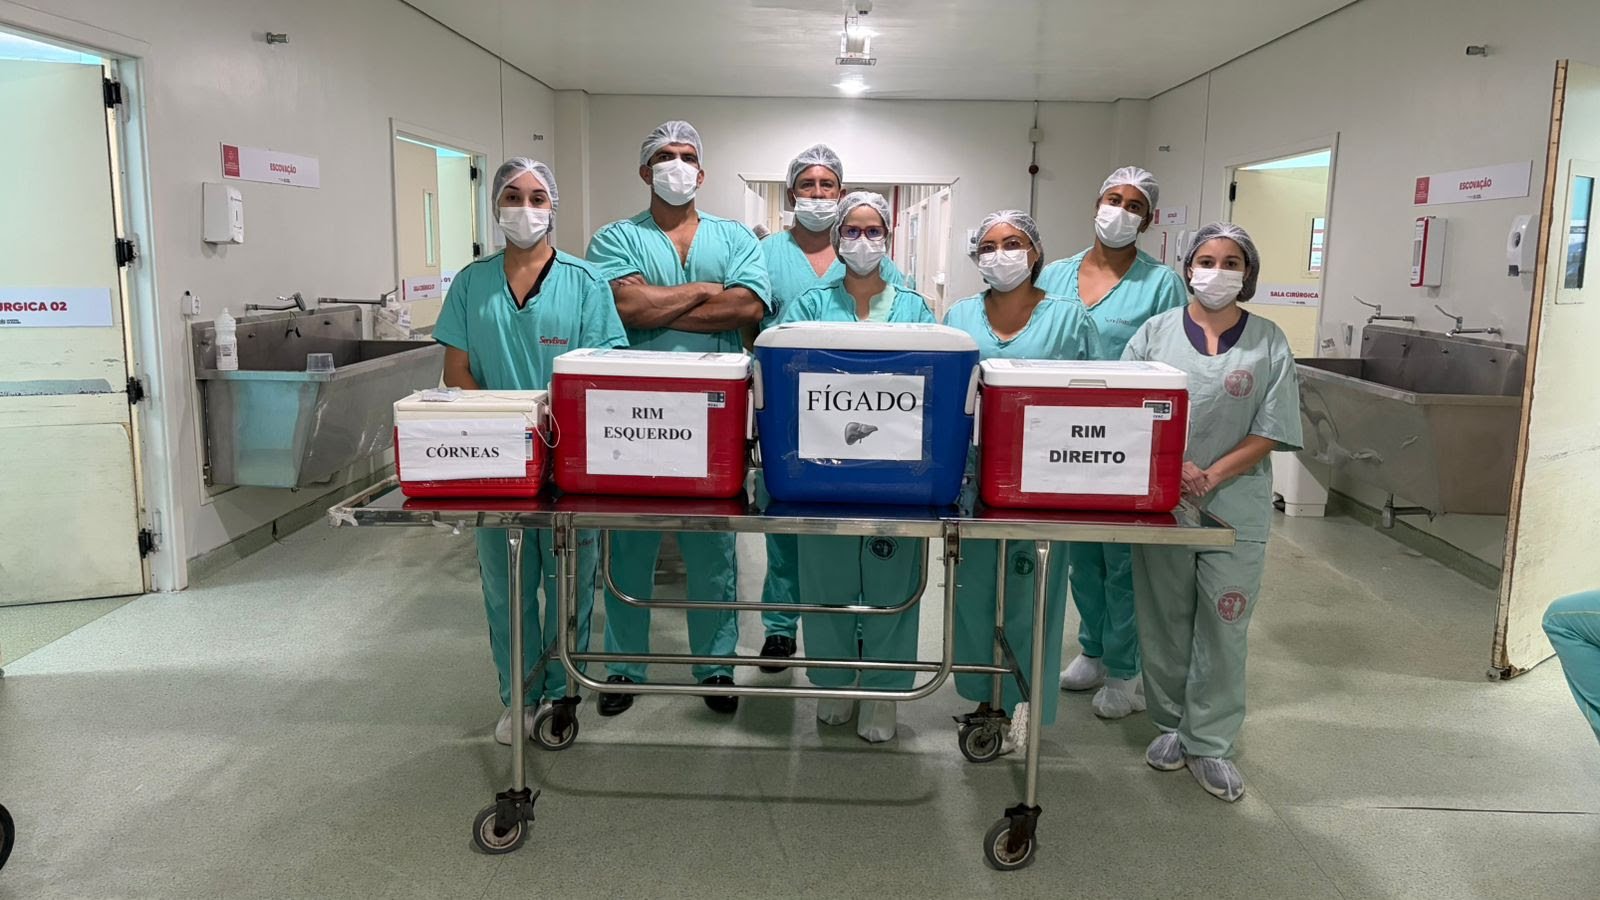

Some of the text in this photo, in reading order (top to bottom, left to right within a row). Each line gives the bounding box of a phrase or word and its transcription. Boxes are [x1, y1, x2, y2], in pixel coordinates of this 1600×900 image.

[269, 162, 297, 175] ESCOVAÇÃO
[1459, 177, 1492, 190] ESCOVAÇÃO
[50, 302, 68, 312] 02
[806, 384, 917, 412] FÍGADO
[631, 407, 665, 420] RIM
[603, 426, 693, 441] ESQUERDO
[1071, 425, 1106, 438] RIM
[426, 444, 500, 459] CÓRNEAS
[1049, 450, 1126, 464] DIREITO
